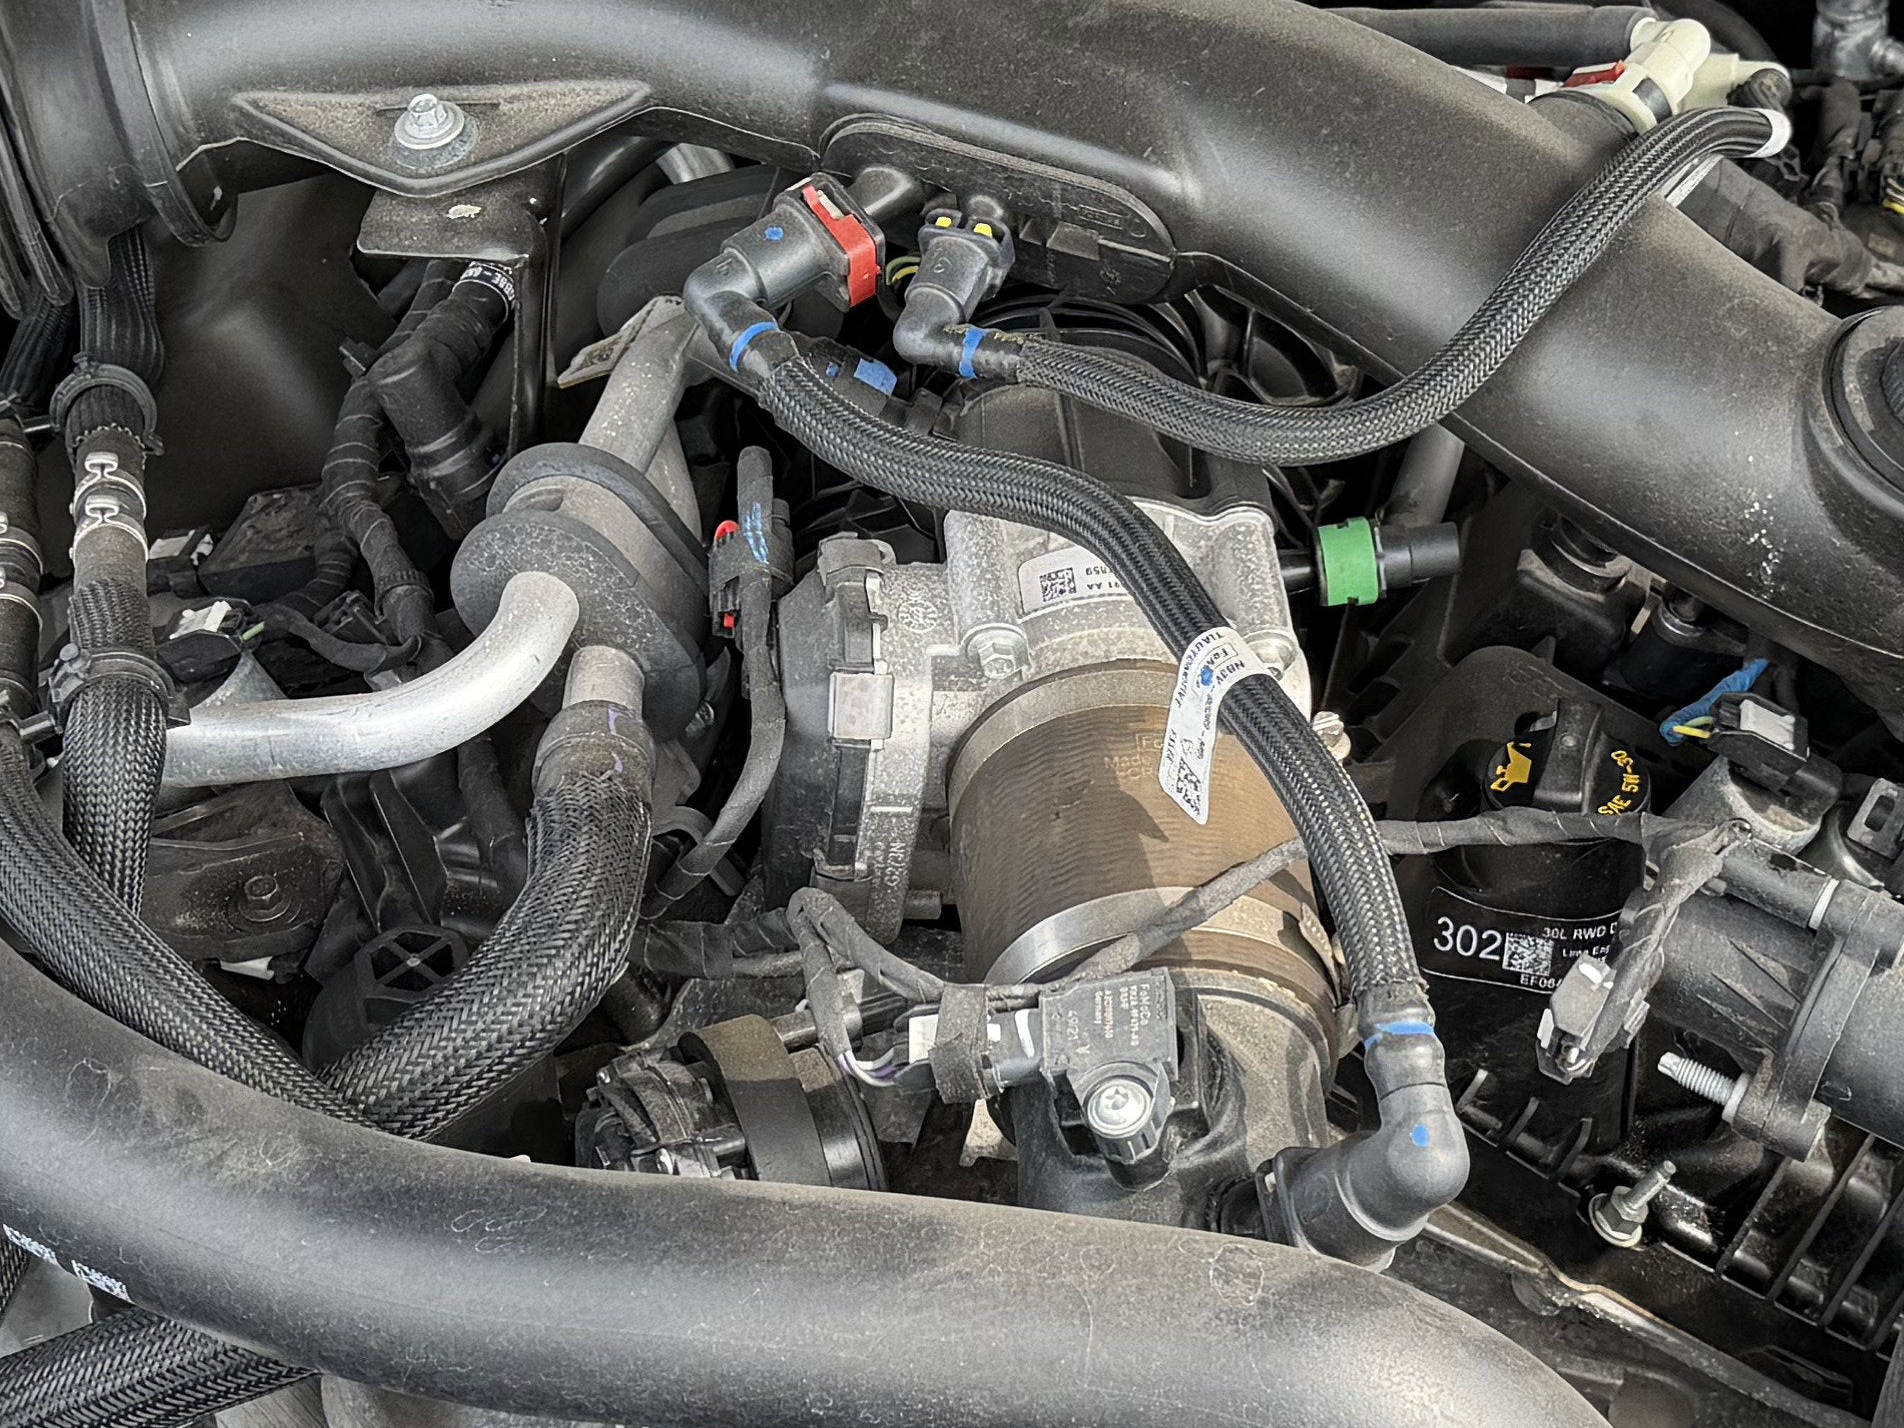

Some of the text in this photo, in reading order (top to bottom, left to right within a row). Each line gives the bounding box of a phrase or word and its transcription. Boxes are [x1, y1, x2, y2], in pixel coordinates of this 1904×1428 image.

[1598, 750, 1641, 817] SAE 5W-30
[1433, 916, 1503, 961] 302
[1543, 926, 1568, 940] 30L
[1572, 924, 1606, 940] RWD
[1139, 983, 1152, 1026] FoMoCo
